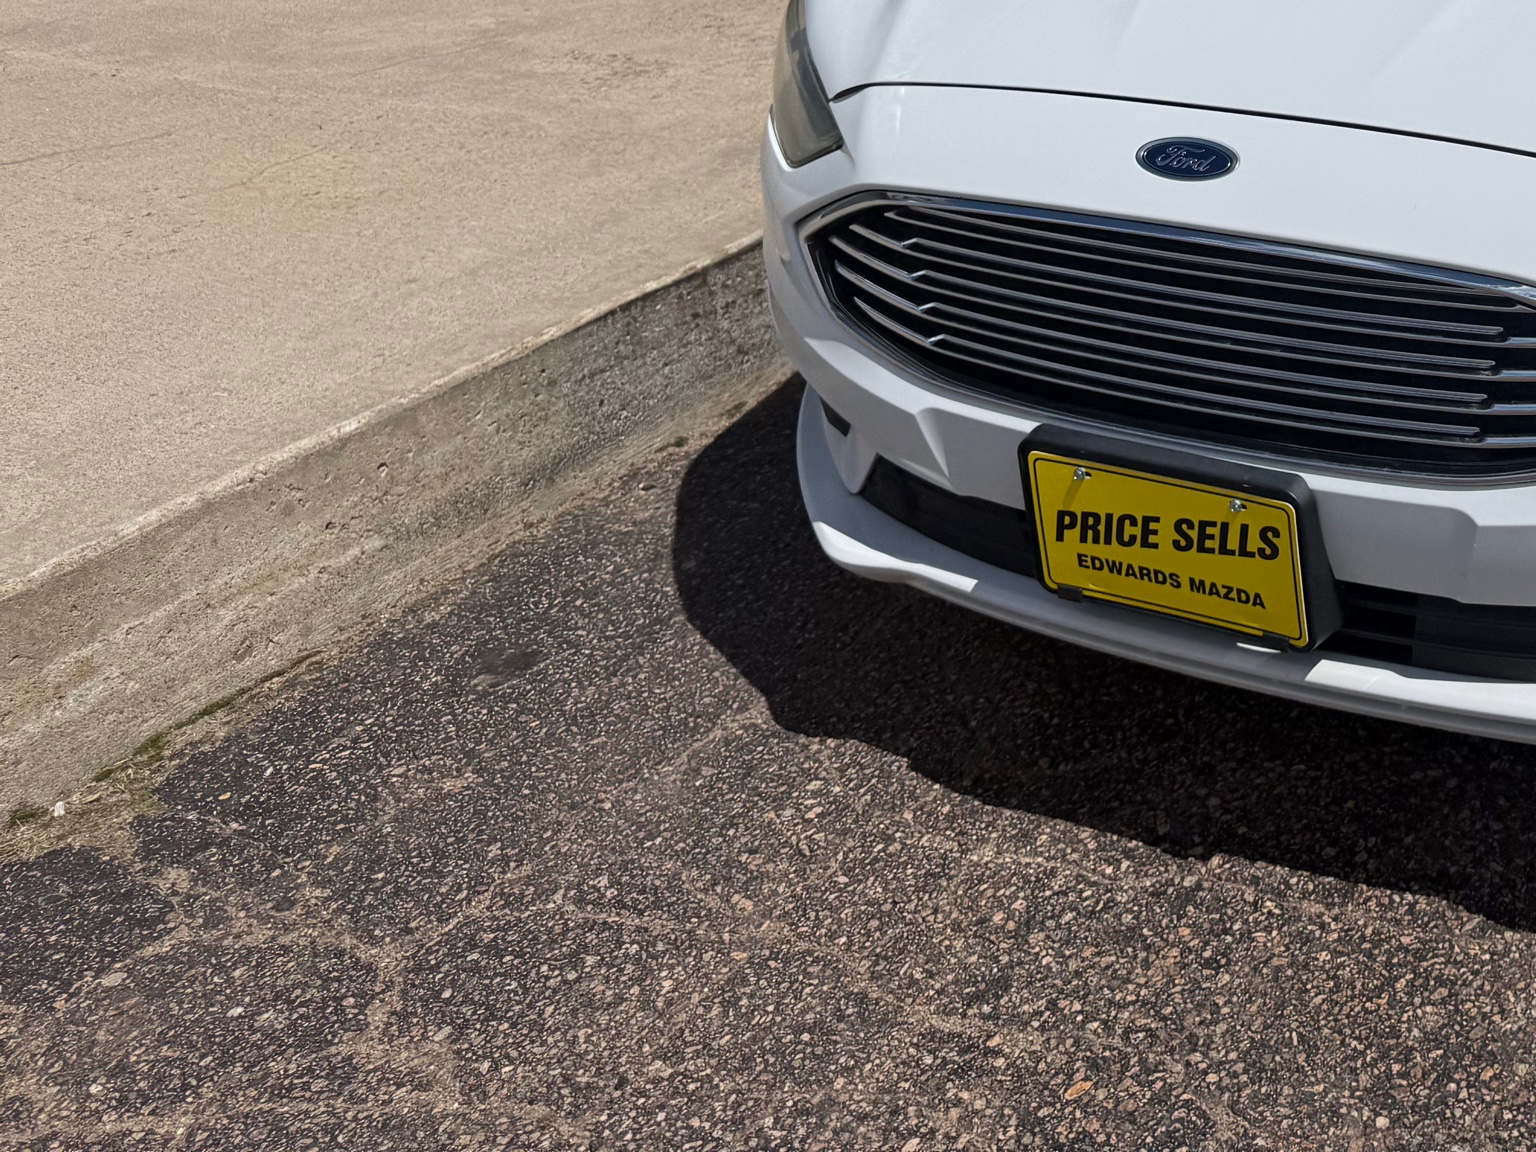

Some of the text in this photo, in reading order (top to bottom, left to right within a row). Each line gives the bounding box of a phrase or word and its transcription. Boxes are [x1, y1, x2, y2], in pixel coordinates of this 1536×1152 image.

[1155, 145, 1217, 172] Ford
[1055, 510, 1281, 560] PRICE SELLS
[1076, 552, 1266, 609] EDWARDS MAZDA
